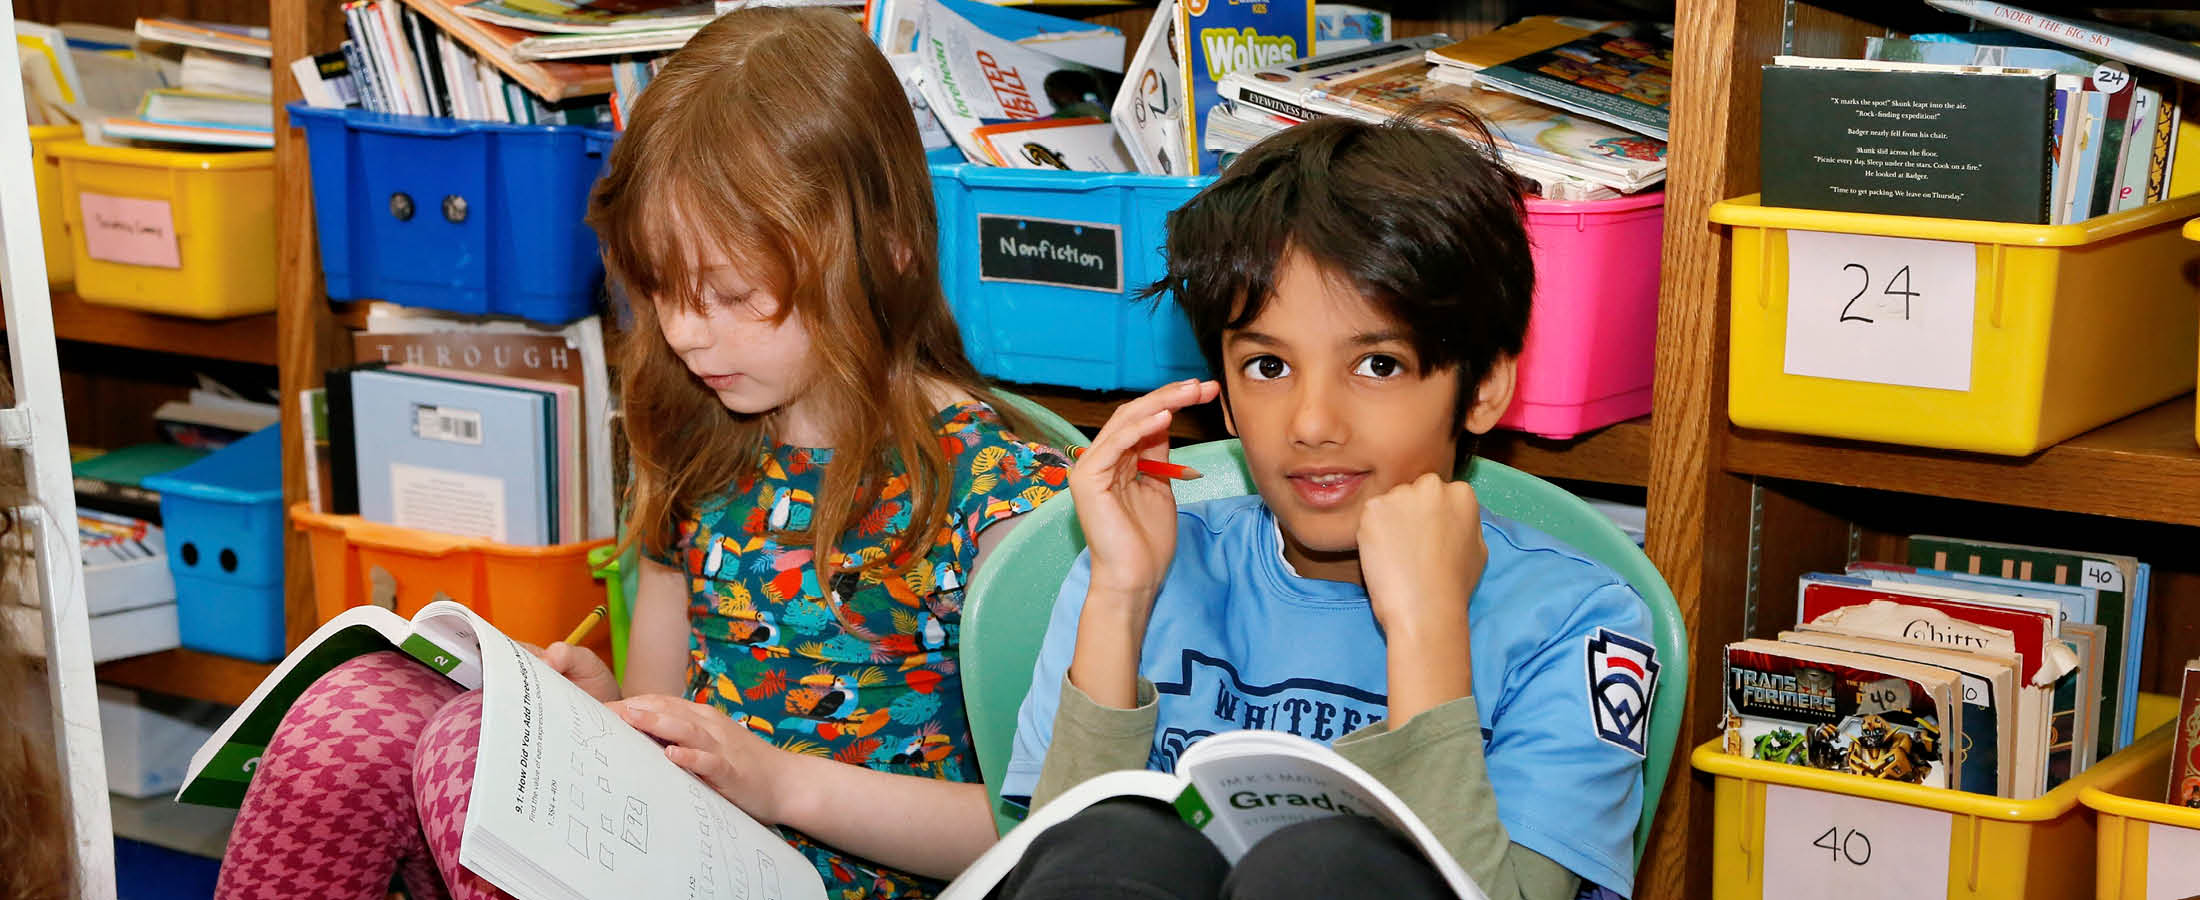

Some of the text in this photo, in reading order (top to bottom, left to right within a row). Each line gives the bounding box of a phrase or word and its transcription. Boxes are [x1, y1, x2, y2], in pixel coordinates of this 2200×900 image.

[1993, 6, 2112, 47] UNDER THE BIG SKY
[1206, 34, 1293, 75] Wolves
[2098, 71, 2124, 85] 24
[1250, 92, 1300, 117] EYEWITNESS
[1892, 100, 1911, 108] Skunk
[1912, 101, 1928, 109] leapt
[1848, 128, 1869, 136] Badger
[1905, 172, 1928, 180] Badger.
[1906, 190, 1921, 198] leave
[1000, 237, 1104, 271] Nonfiction
[1840, 263, 1921, 323] 24
[376, 344, 568, 369] THROUGH
[2089, 568, 2112, 584] 40
[434, 655, 449, 667] 2
[1731, 667, 1797, 691] TRANS
[1743, 685, 1836, 713] FORMERS
[1871, 688, 1896, 711] 40
[523, 706, 531, 729] Add
[522, 729, 530, 748] You
[520, 748, 529, 768] Did
[536, 759, 541, 769] of
[517, 769, 527, 794] How
[515, 794, 525, 815] 9.1:
[531, 791, 539, 805] the
[529, 804, 537, 823] Find
[1813, 826, 1872, 866] 40
